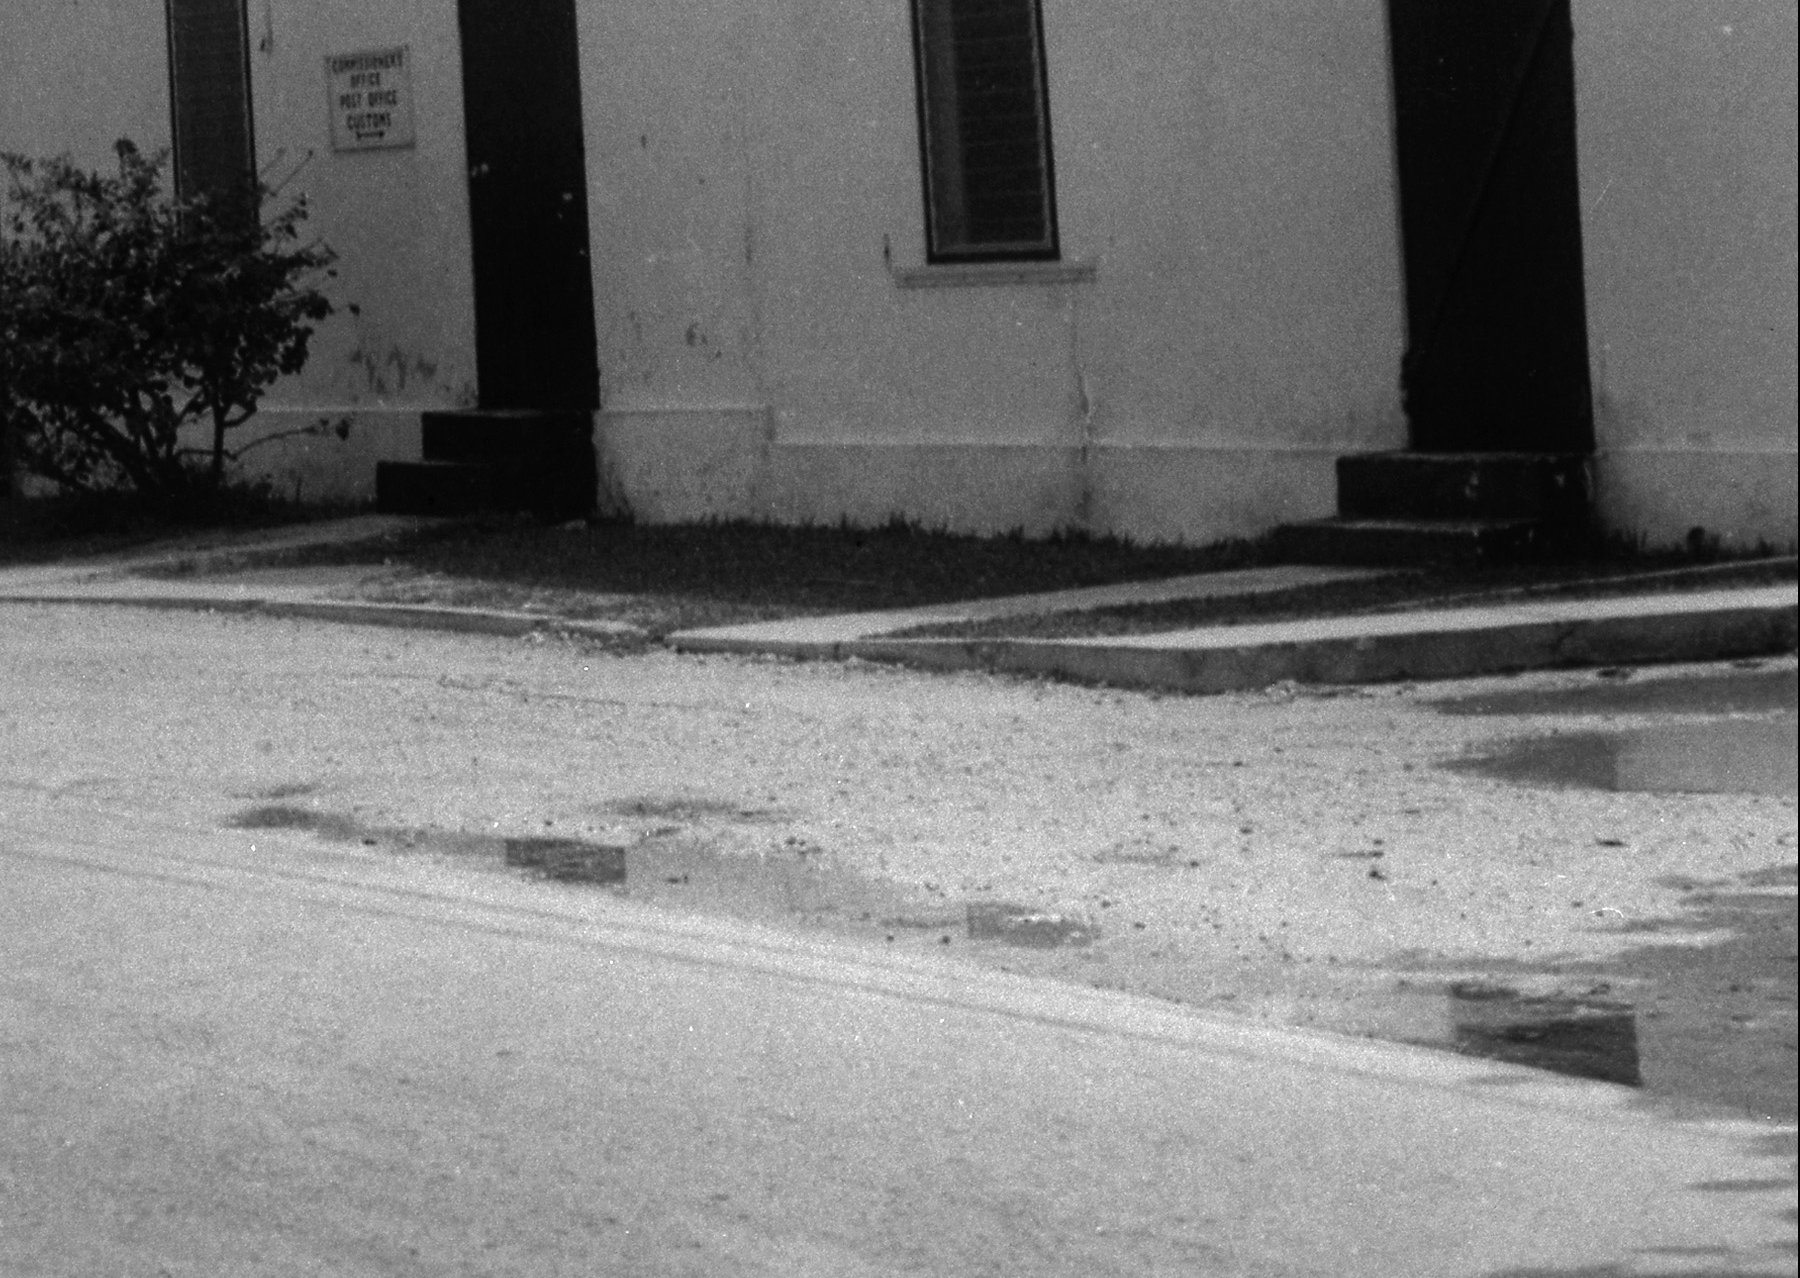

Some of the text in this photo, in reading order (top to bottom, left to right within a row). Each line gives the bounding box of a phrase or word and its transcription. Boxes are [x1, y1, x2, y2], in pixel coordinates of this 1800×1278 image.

[350, 72, 380, 88] OFFICE
[340, 90, 397, 109] POST OFFICE
[347, 113, 391, 130] CUSTOMS
